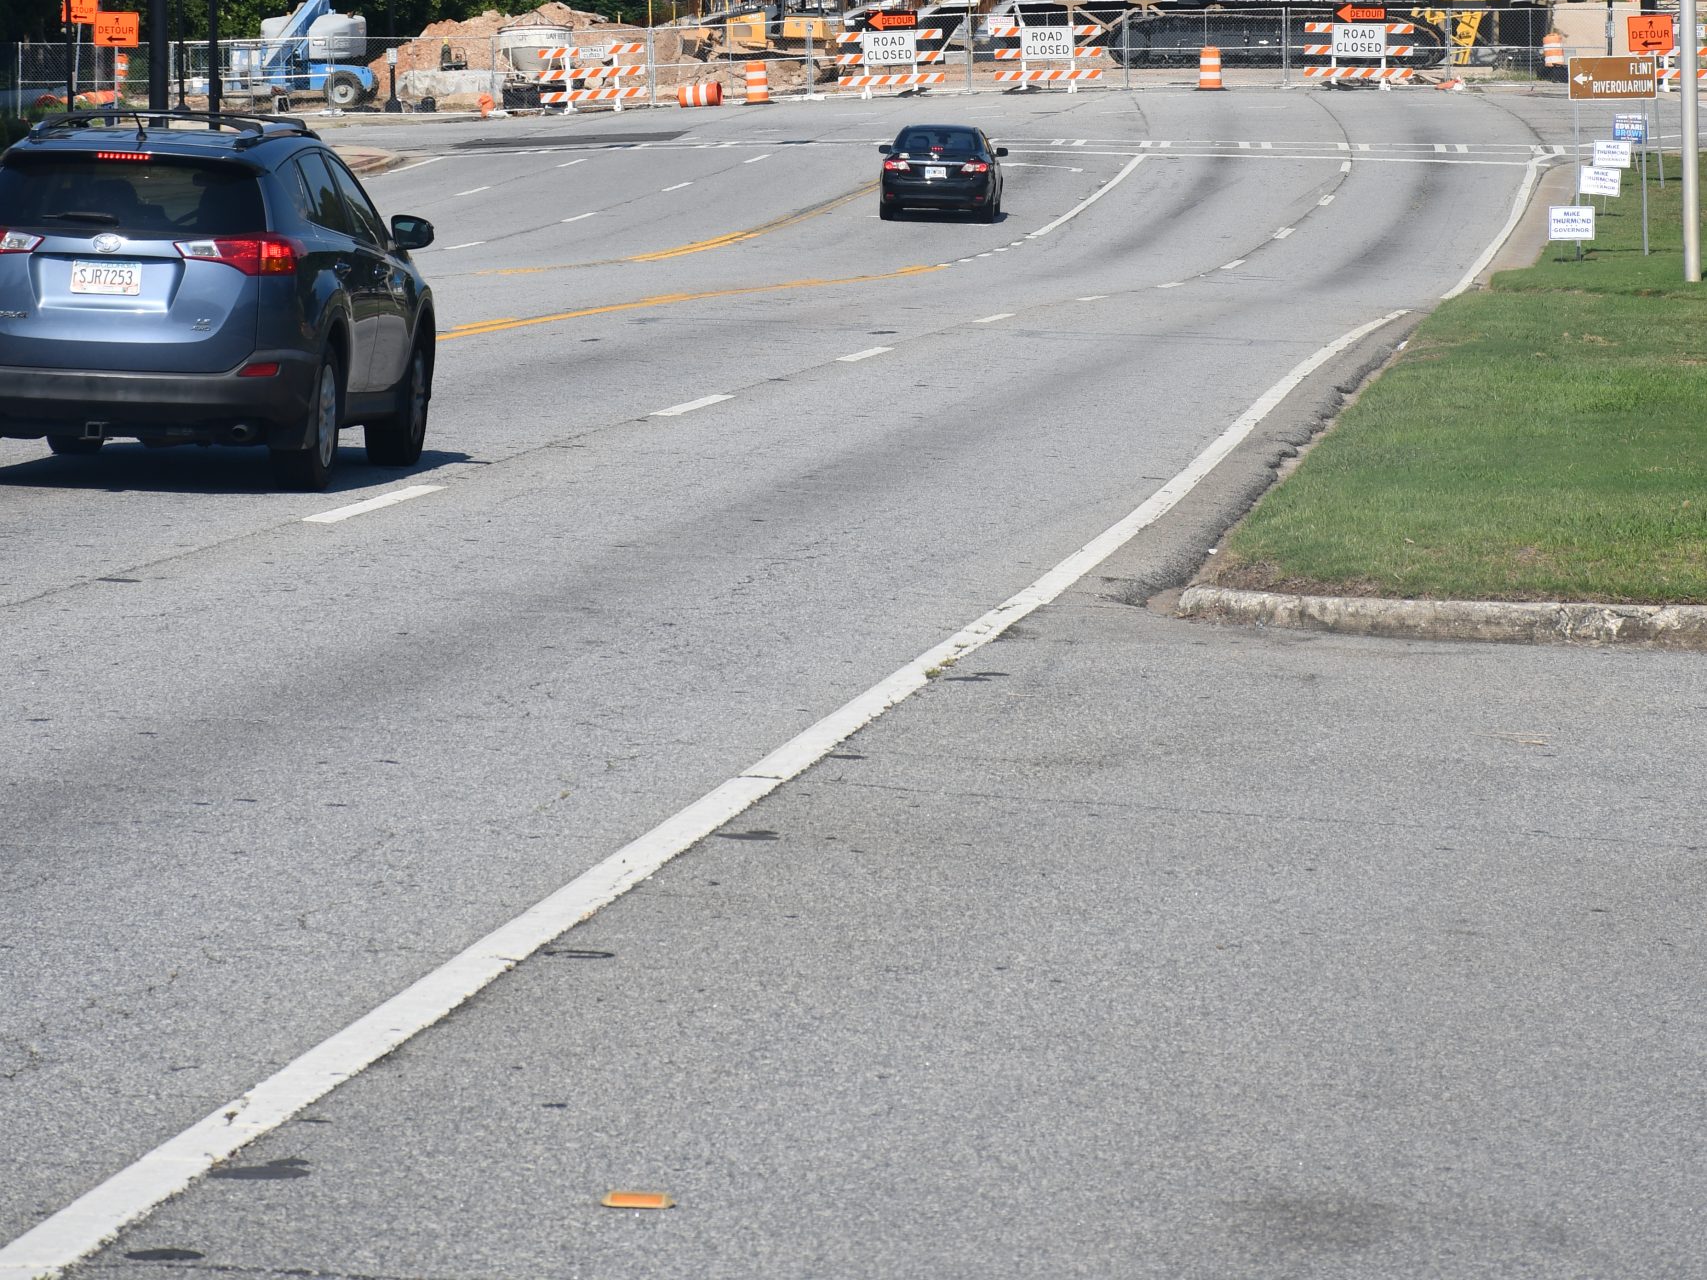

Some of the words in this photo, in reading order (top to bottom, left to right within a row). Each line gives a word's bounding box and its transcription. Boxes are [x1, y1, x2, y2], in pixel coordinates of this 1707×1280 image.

[71, 6, 94, 14] ETOUR
[1350, 9, 1382, 18] DETOUR
[881, 16, 914, 25] DETOUR
[98, 25, 134, 35] DETOUR
[1343, 29, 1375, 39] ROAD
[1631, 29, 1670, 39] DETOUR
[1031, 31, 1063, 41] ROAD
[873, 36, 905, 47] ROAD
[1026, 44, 1070, 55] CLOSED
[1336, 42, 1382, 53] CLOSED
[867, 50, 912, 60] CLOSED
[1629, 62, 1653, 75] FLINT
[1592, 80, 1654, 94] RIVERQUARIUM
[79, 268, 133, 286] SJR7253
